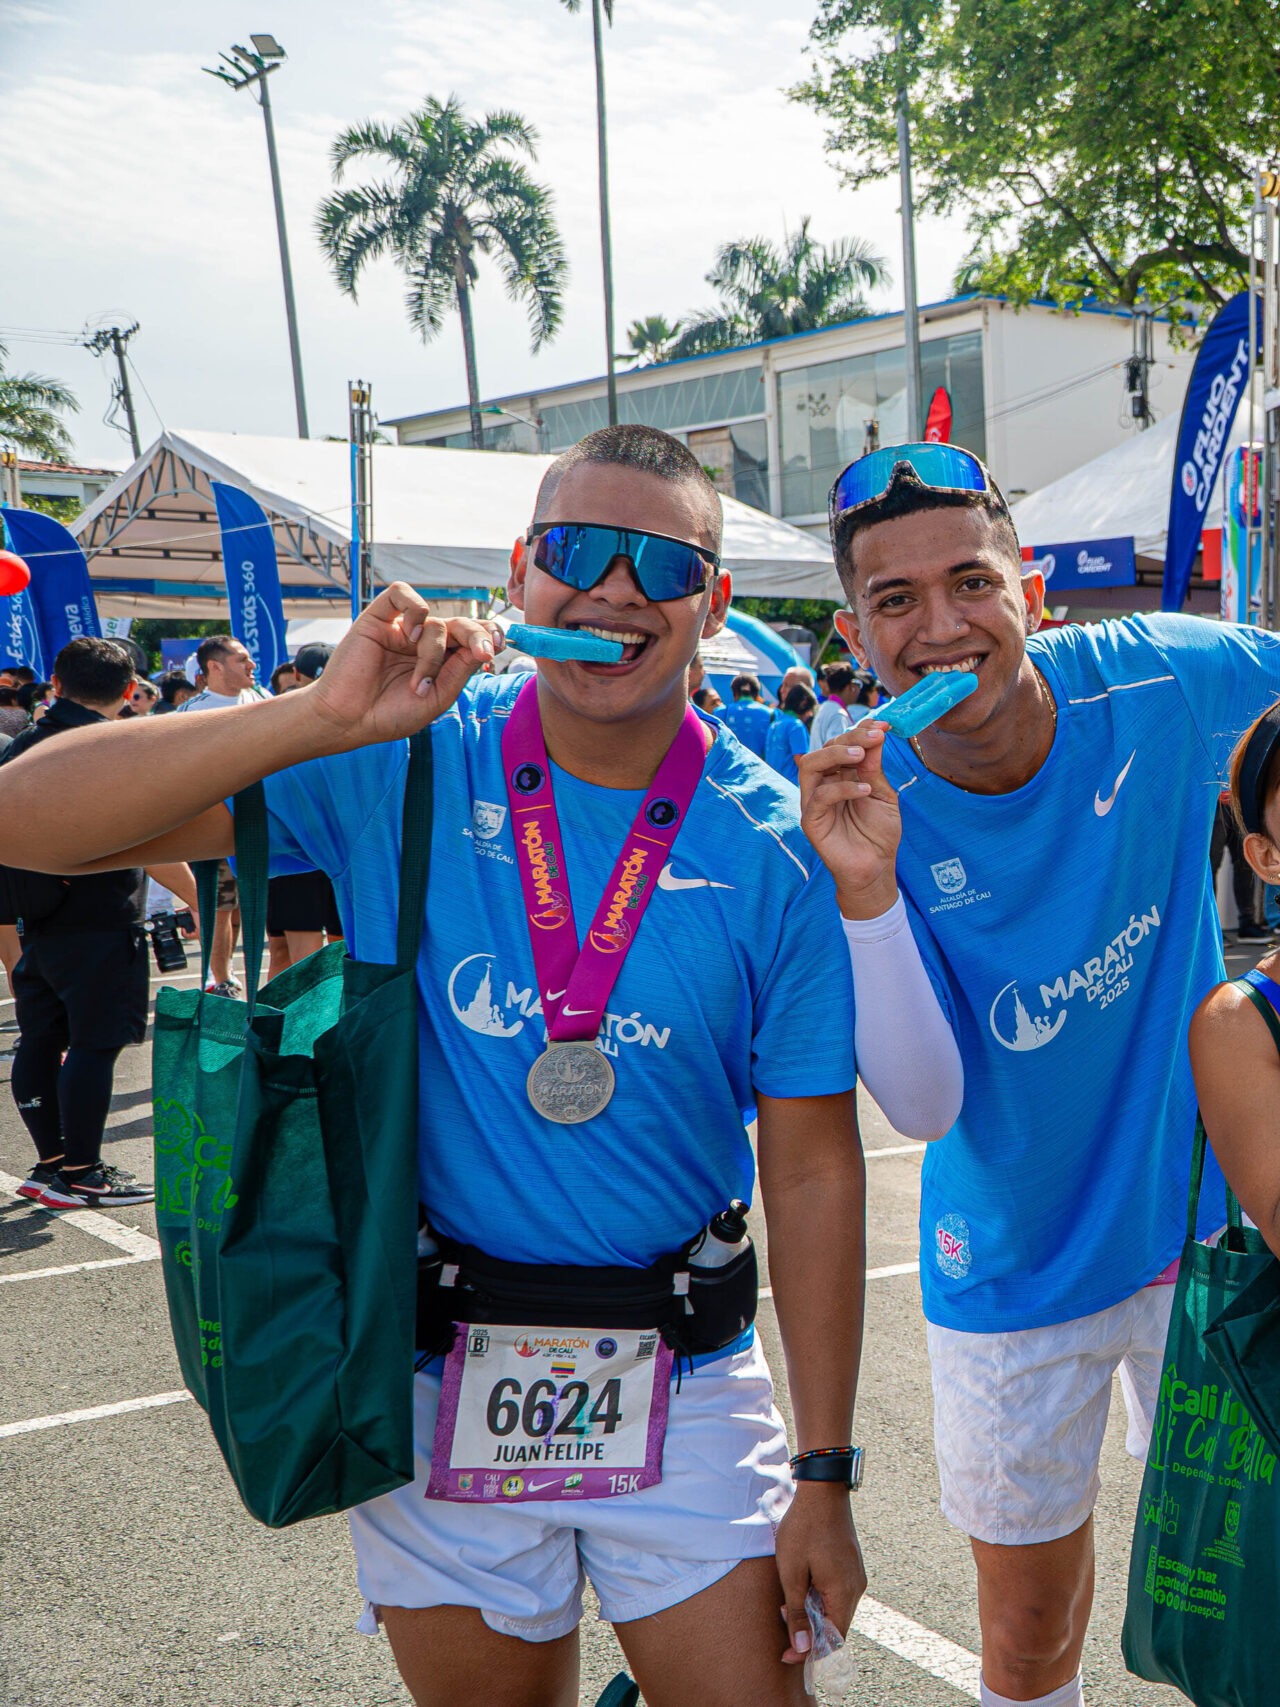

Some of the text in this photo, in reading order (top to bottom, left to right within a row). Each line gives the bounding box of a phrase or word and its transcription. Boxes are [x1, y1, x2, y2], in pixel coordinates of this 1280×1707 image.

[1193, 373, 1226, 469] FLUO
[1195, 338, 1248, 513] CARDENT
[241, 560, 255, 593] 360
[496, 853, 514, 865] CALI
[521, 821, 554, 905] MARATÓN
[543, 842, 560, 879] DE CALI
[603, 848, 649, 929] MARATÓN
[627, 874, 649, 910] DE CALI
[929, 890, 992, 914] SANTIAGO DE CALI
[940, 888, 977, 904] ALCALDÍA DE
[1039, 905, 1161, 1009] MARATÓN
[1086, 952, 1134, 1003] DE CALI
[1099, 976, 1131, 1010] 2025
[505, 981, 671, 1049] MATÓN
[938, 1229, 963, 1263] 15K
[473, 1337, 484, 1352] B
[534, 1336, 590, 1349] MARATÓN
[486, 1377, 623, 1438] 6624
[1169, 1379, 1219, 1420] Cali
[493, 1443, 605, 1463] JUAN FELIPE
[608, 1474, 641, 1494] 15K
[1197, 1567, 1217, 1584] haz
[1189, 1586, 1227, 1606] cambio
